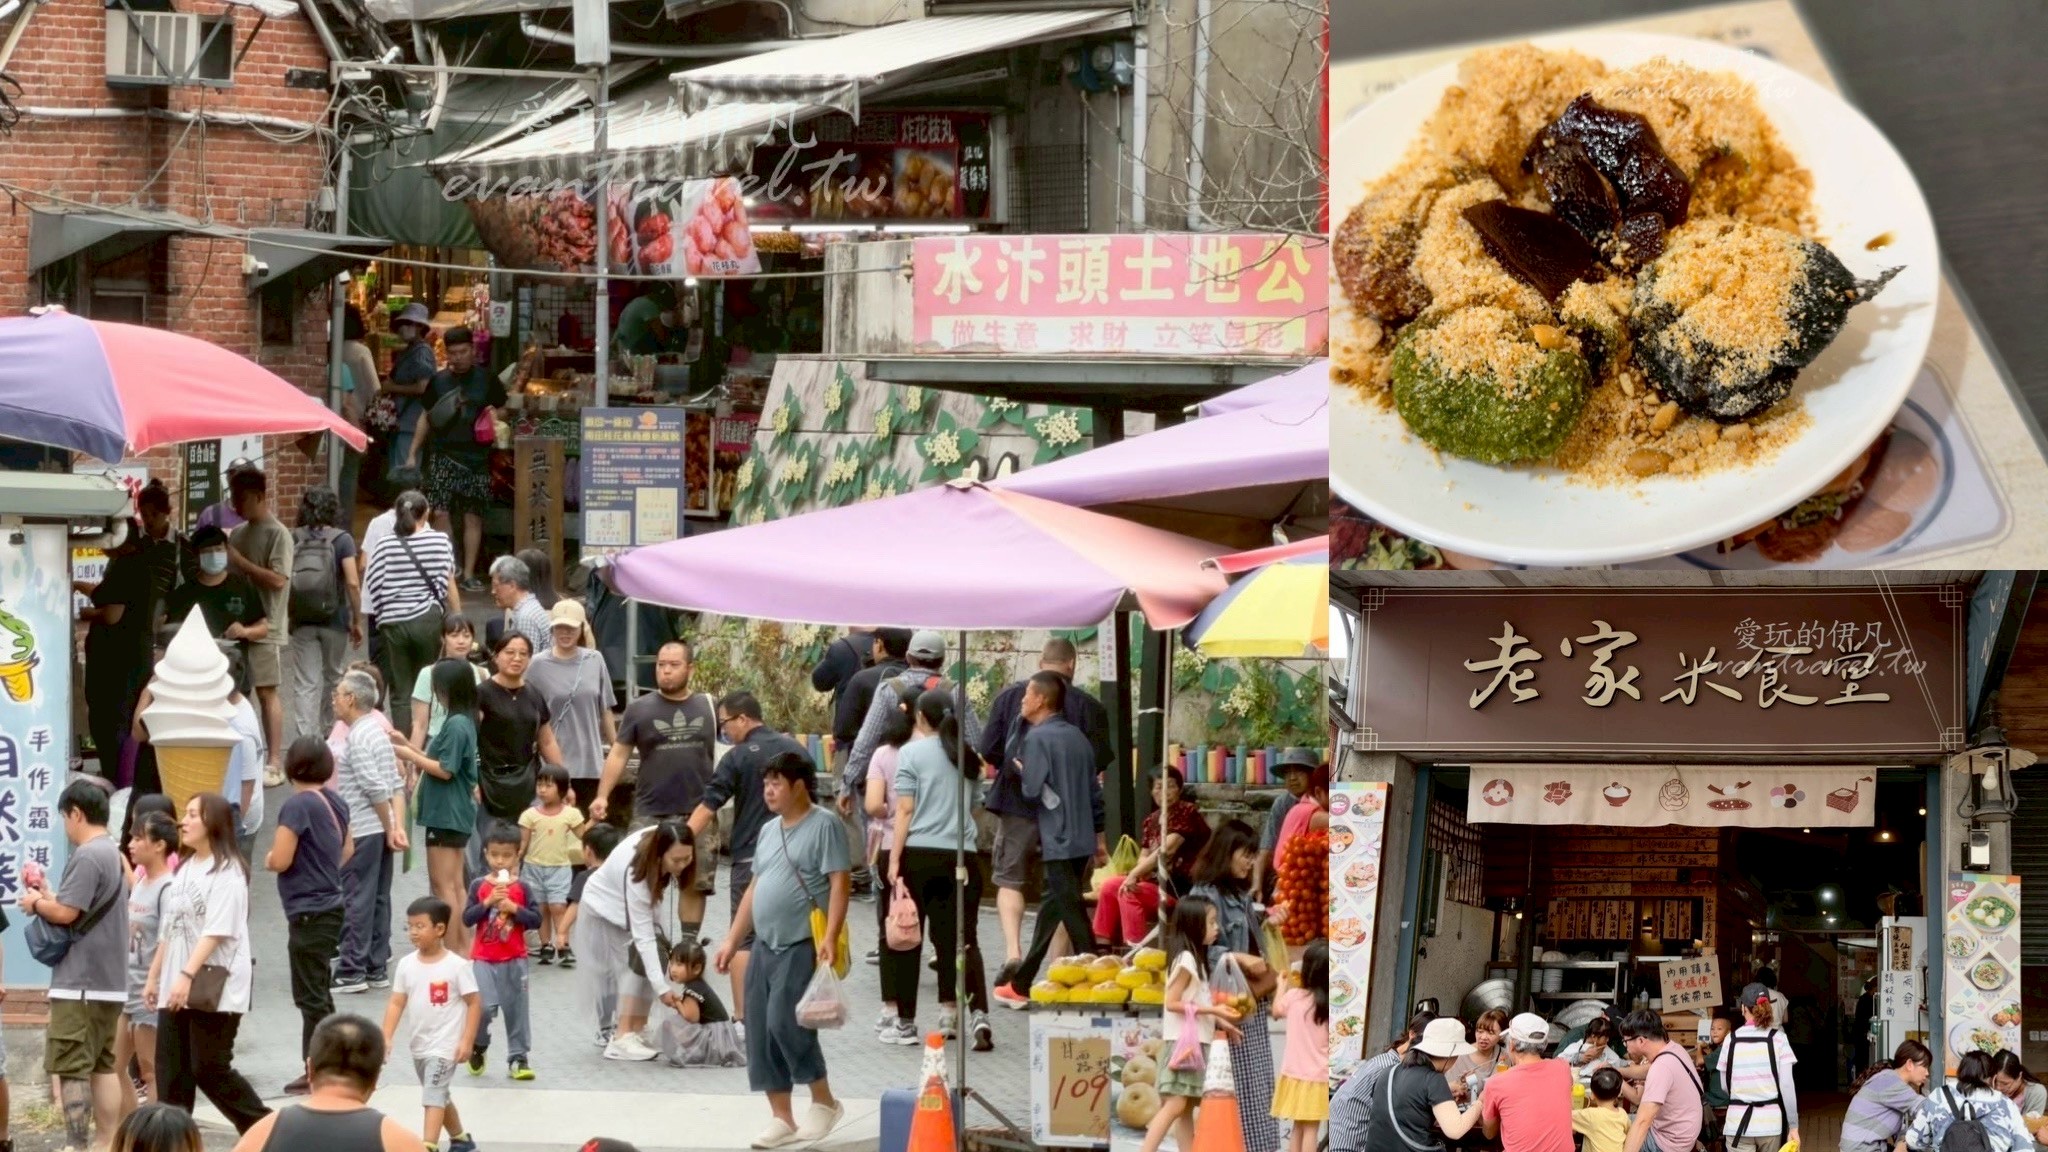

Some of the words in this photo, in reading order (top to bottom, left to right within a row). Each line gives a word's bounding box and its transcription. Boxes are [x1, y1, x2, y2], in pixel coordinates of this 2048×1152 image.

[933, 235, 1311, 305] 水汴頭土地公
[952, 321, 1039, 349] 做生意
[1069, 321, 1129, 349] 求財
[1464, 621, 1890, 709] 老家米食堂
[1053, 1074, 1110, 1112] 109
